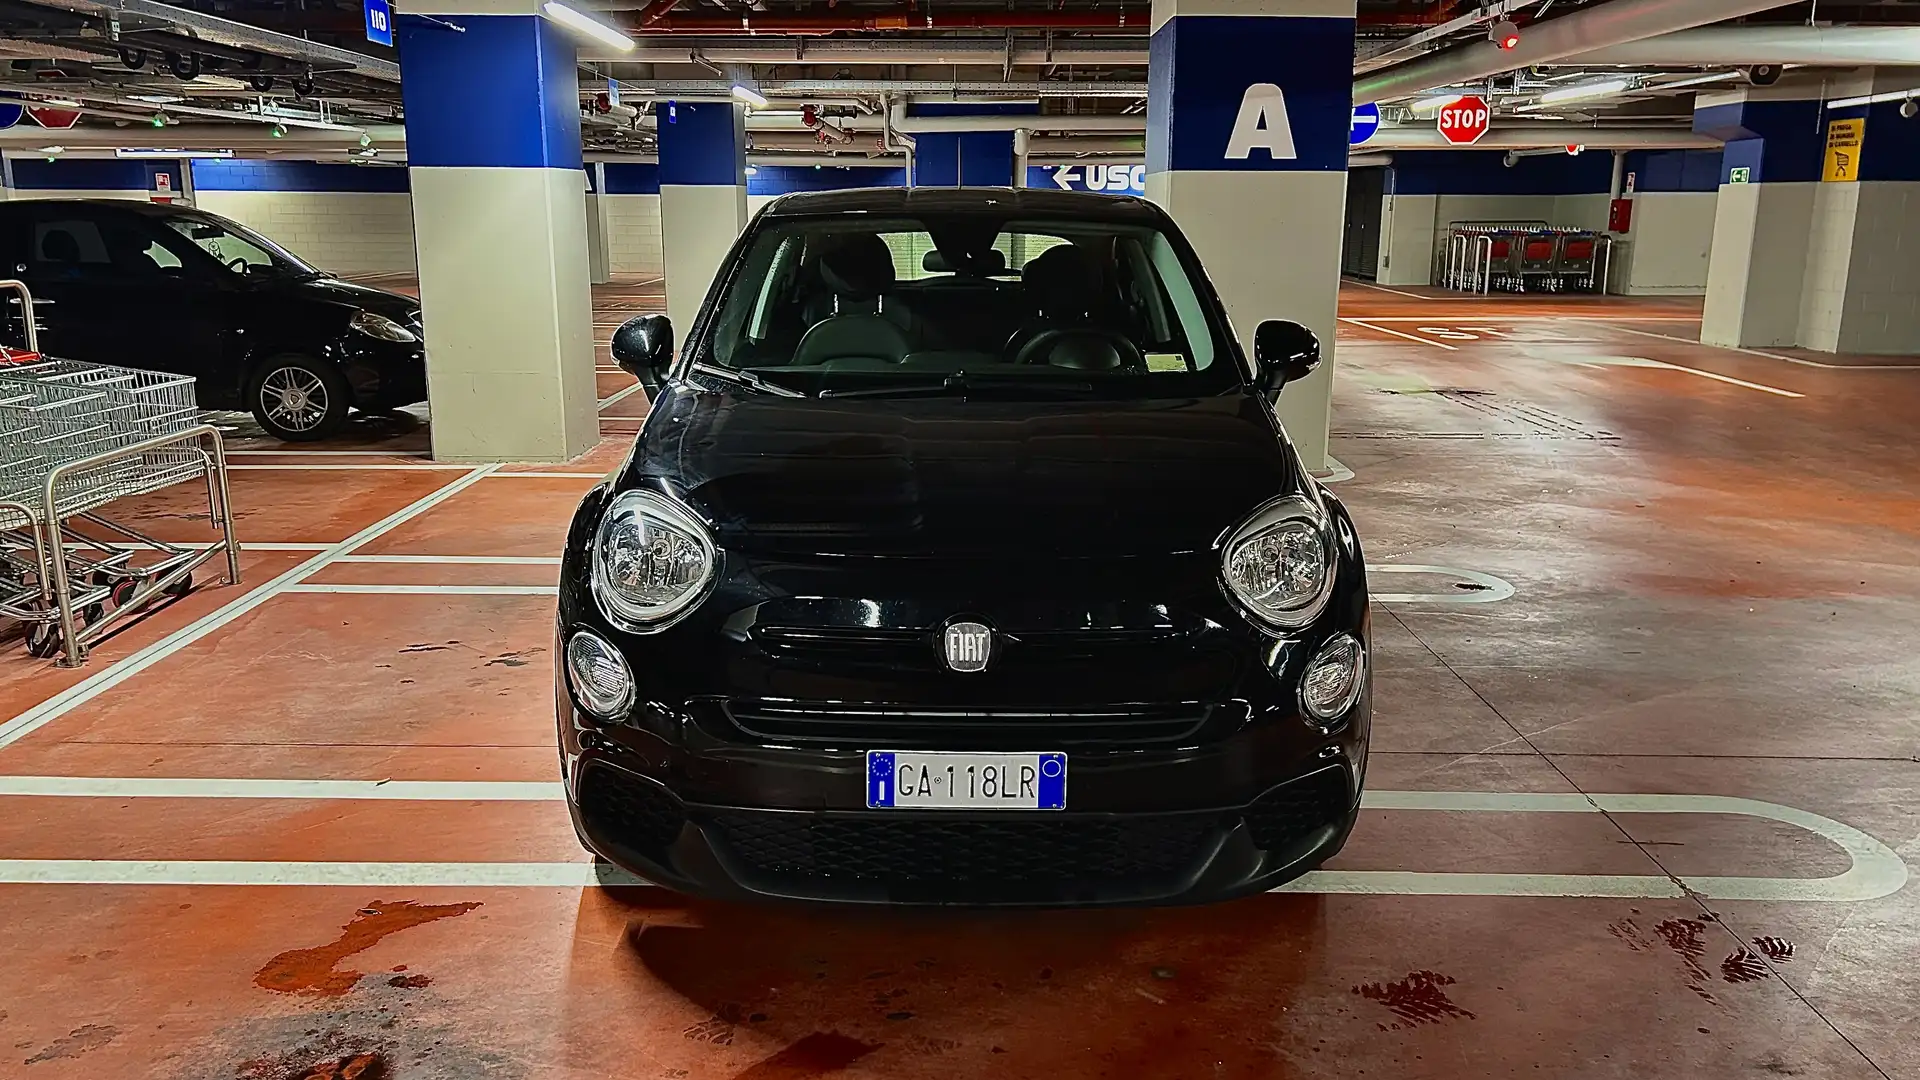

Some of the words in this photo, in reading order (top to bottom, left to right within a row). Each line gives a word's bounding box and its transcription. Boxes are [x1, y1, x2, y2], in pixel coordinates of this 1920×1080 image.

[371, 9, 386, 31] 110
[1224, 83, 1297, 159] A
[1441, 109, 1487, 129] STOP
[1086, 165, 1146, 190] USC
[950, 632, 986, 662] FIAT
